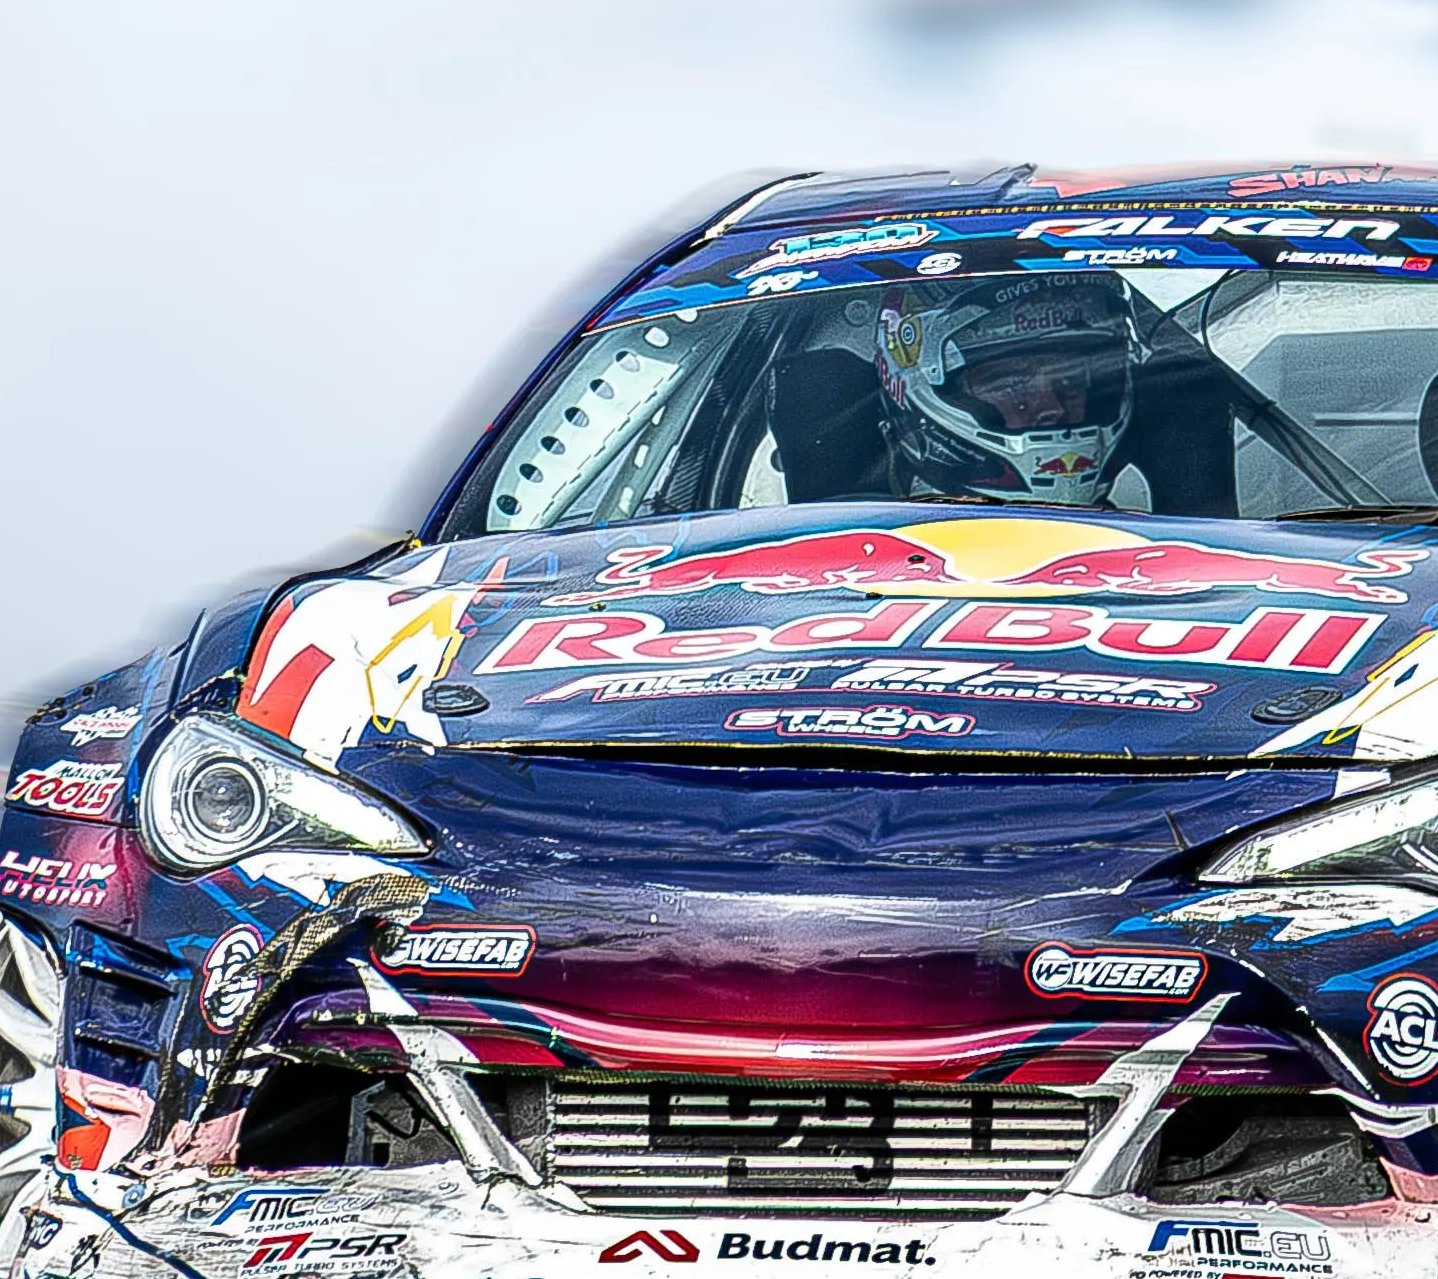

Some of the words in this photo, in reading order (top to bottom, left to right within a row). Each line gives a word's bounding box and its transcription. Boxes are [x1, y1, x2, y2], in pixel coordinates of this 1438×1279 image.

[1017, 217, 1400, 240] FALKEN
[995, 279, 1040, 303] GIVES
[1044, 274, 1076, 286] YOU
[488, 600, 932, 670] Red
[938, 603, 1376, 672] Bull
[831, 680, 945, 693] PULSAR
[958, 685, 1059, 700] TURBO
[1062, 691, 1196, 709] SYSTEMS
[964, 670, 1210, 699] PSR
[734, 707, 967, 732] STRÖM
[10, 772, 118, 809] TOOLS
[411, 939, 529, 963] WISEFAB
[1071, 961, 1200, 989] WISEFAB
[245, 1214, 360, 1233] PERFORMANCE
[298, 1233, 407, 1259] PSR
[1147, 1220, 1332, 1261] FMIC.EU
[341, 1257, 399, 1270] SYSTEMS
[1196, 1257, 1333, 1274] PERFORMANCE
